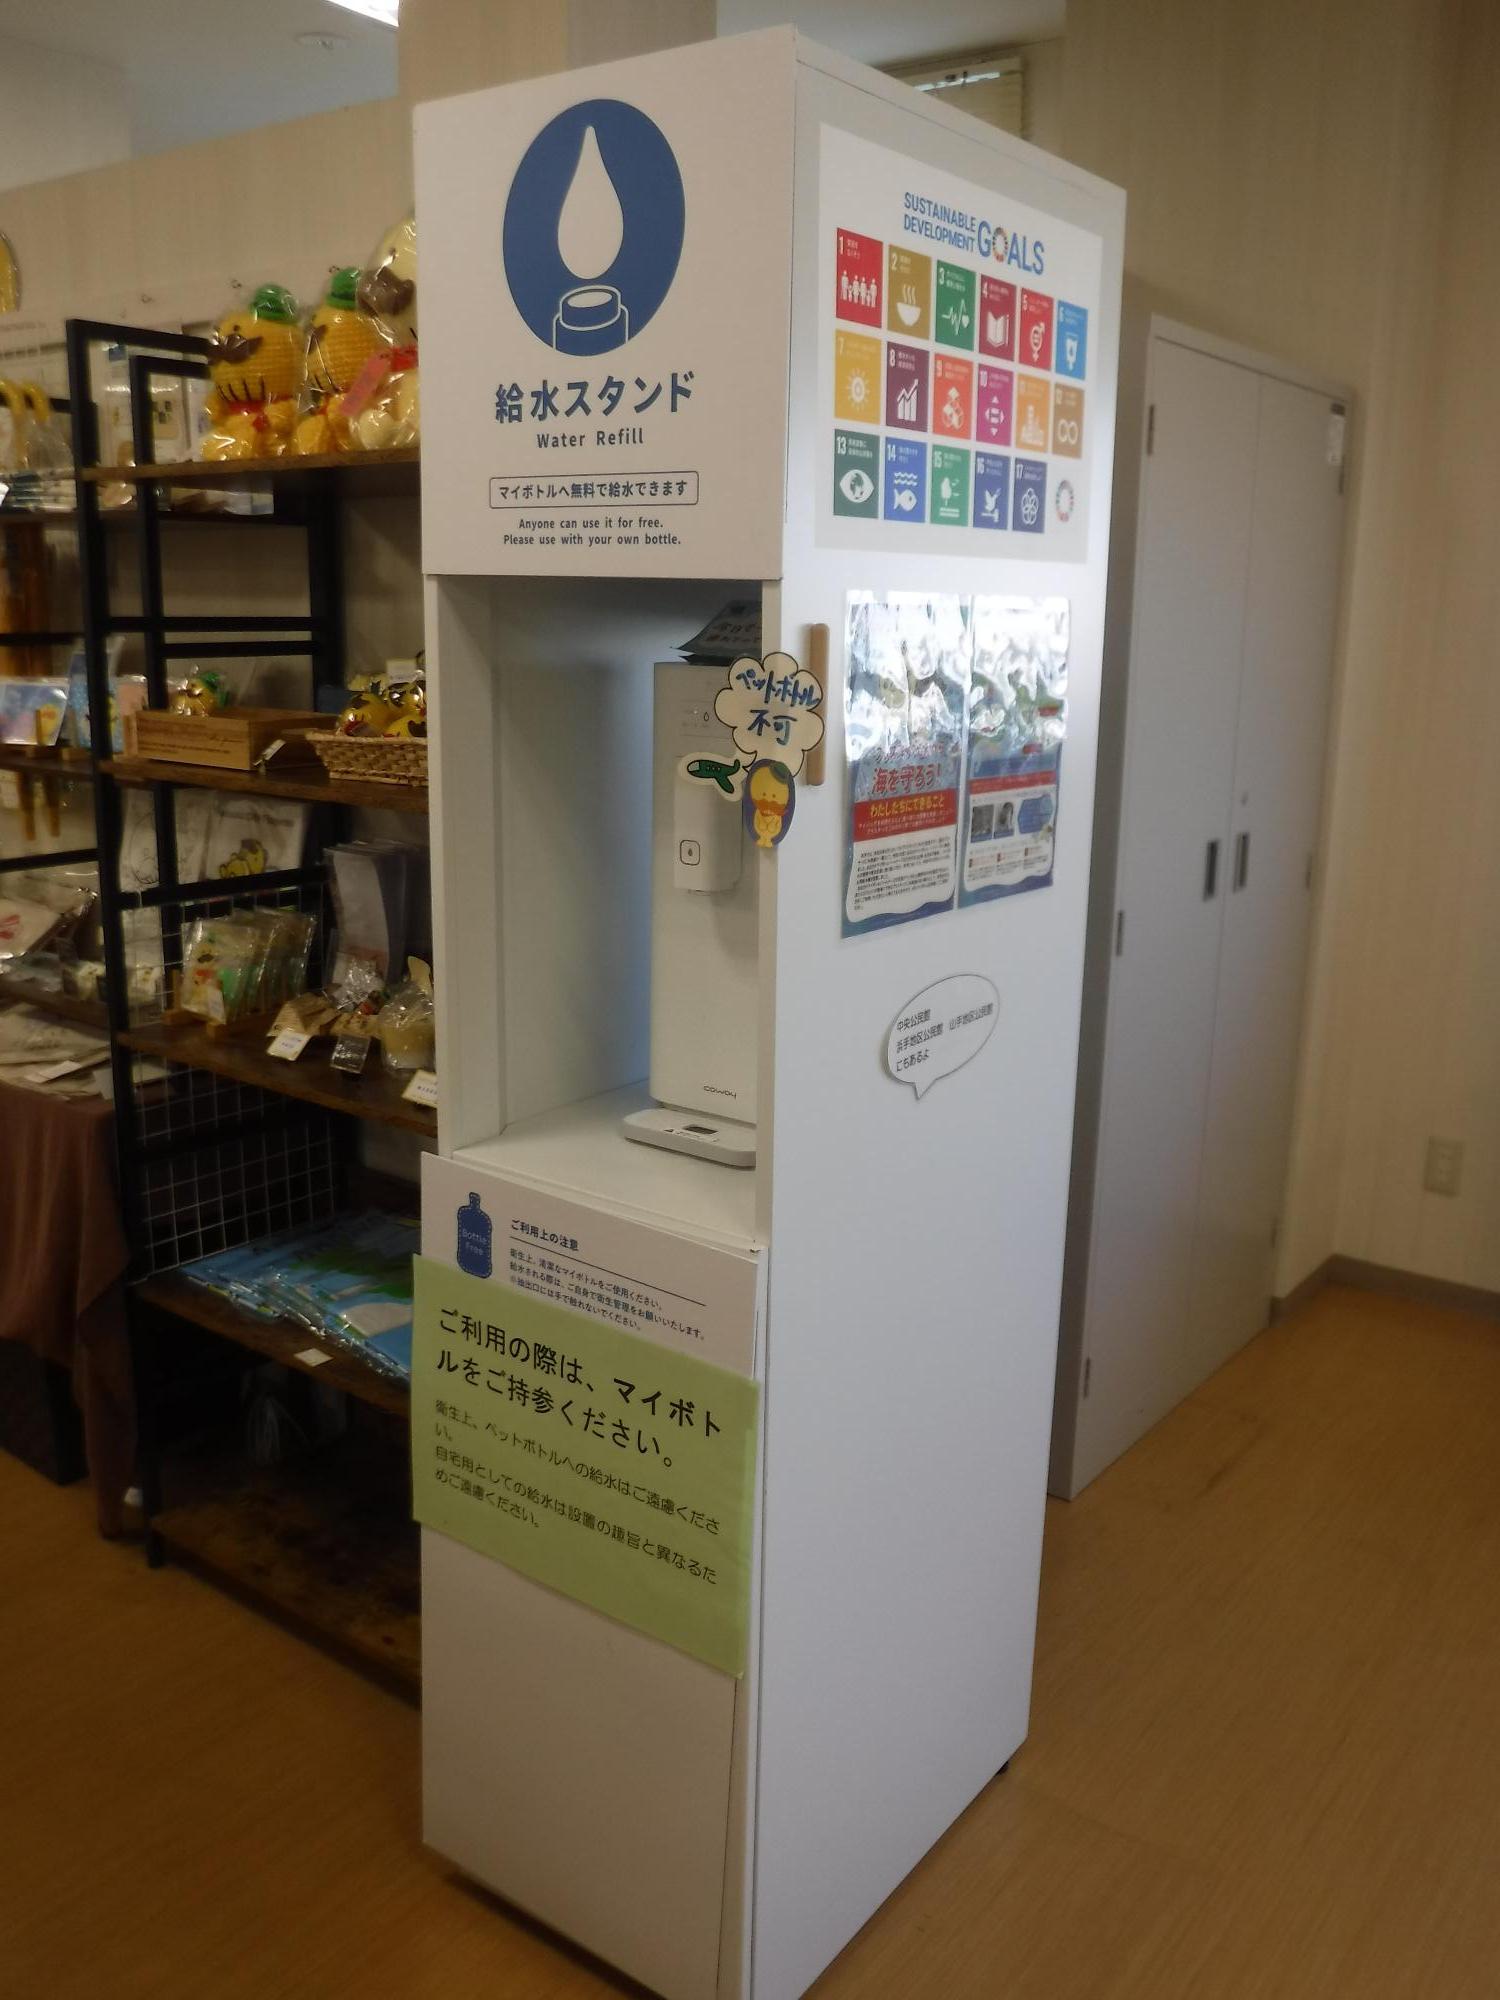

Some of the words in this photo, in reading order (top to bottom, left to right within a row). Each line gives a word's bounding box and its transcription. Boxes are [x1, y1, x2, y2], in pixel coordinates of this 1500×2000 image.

[903, 191, 976, 233] SUSTAINABLE
[903, 213, 976, 252] DEVELOPMENT
[890, 253, 898, 271] 2
[977, 220, 1045, 276] GOALS
[939, 267, 946, 286] 3
[889, 348, 896, 367] 8
[495, 370, 695, 424] 給水スタンド
[537, 433, 586, 449] Water
[596, 427, 644, 447] Refill
[836, 436, 847, 455] 13
[887, 444, 897, 461] 14
[499, 480, 688, 500] マイボトルへ無料で給水できます
[519, 517, 555, 532] Anyone
[560, 519, 578, 529] can
[582, 518, 600, 529] use
[605, 516, 613, 529] it
[617, 515, 634, 529] for
[638, 516, 664, 529] free.
[503, 534, 534, 545] Please
[539, 535, 556, 545] use
[561, 533, 583, 545] with
[588, 535, 613, 547] your
[617, 535, 640, 545] own
[644, 532, 681, 545] bottle.
[735, 669, 821, 707] ペットボトル
[747, 709, 798, 747] 不可
[510, 1218, 579, 1252] ご利用上の注意
[439, 1308, 721, 1437] ご利用の際は、マイボト
[436, 1349, 673, 1468] ルをご持参ください。
[434, 1424, 454, 1442] い。
[434, 1468, 540, 1529] めご遠慮ください。
